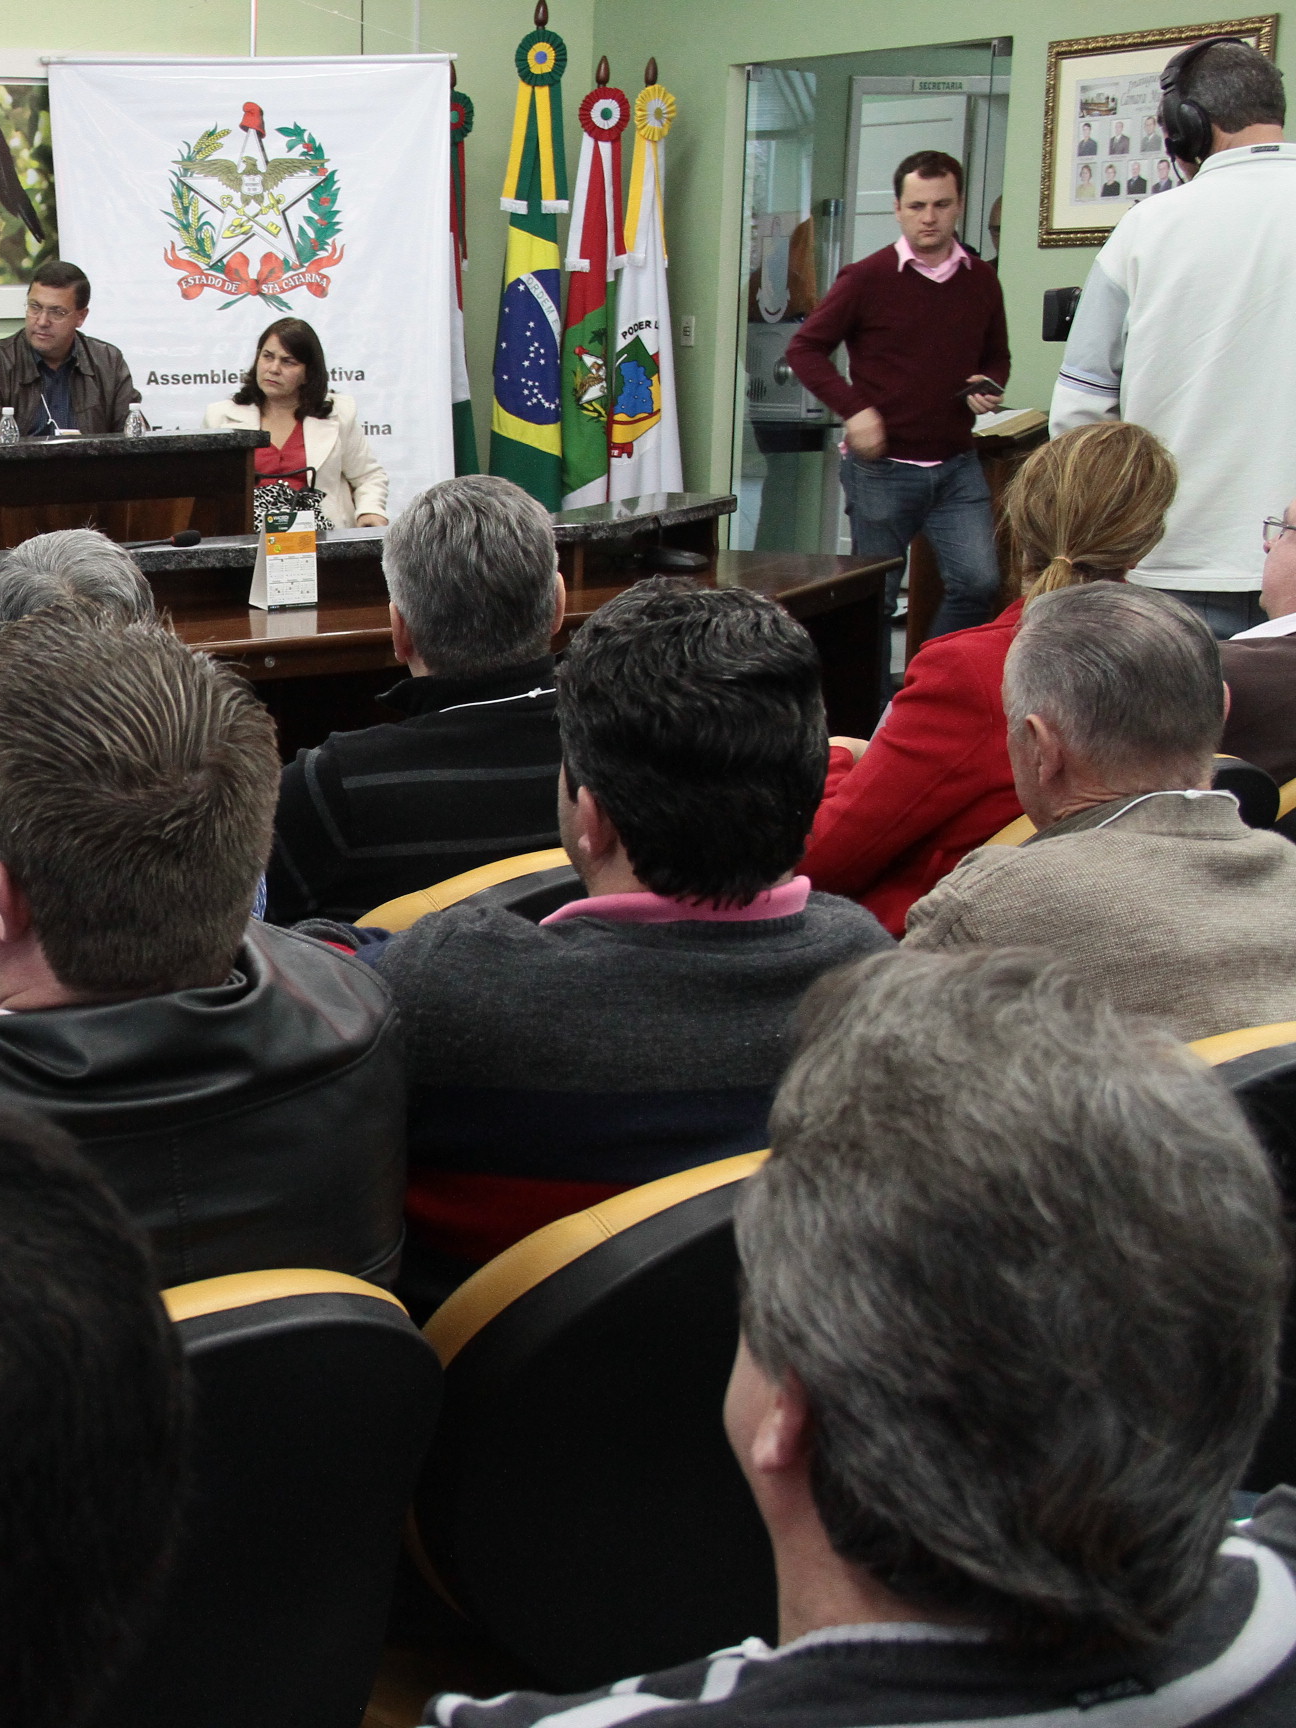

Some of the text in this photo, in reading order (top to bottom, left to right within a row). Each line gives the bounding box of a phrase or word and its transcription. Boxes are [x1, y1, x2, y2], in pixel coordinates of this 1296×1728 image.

[919, 81, 963, 90] SECRETARIA
[181, 275, 223, 289] ESTADO
[225, 281, 239, 293] DE
[283, 272, 327, 289] CATARINA
[526, 276, 556, 315] ORDEM
[620, 319, 652, 340] PODER
[146, 369, 245, 386] Assemblei
